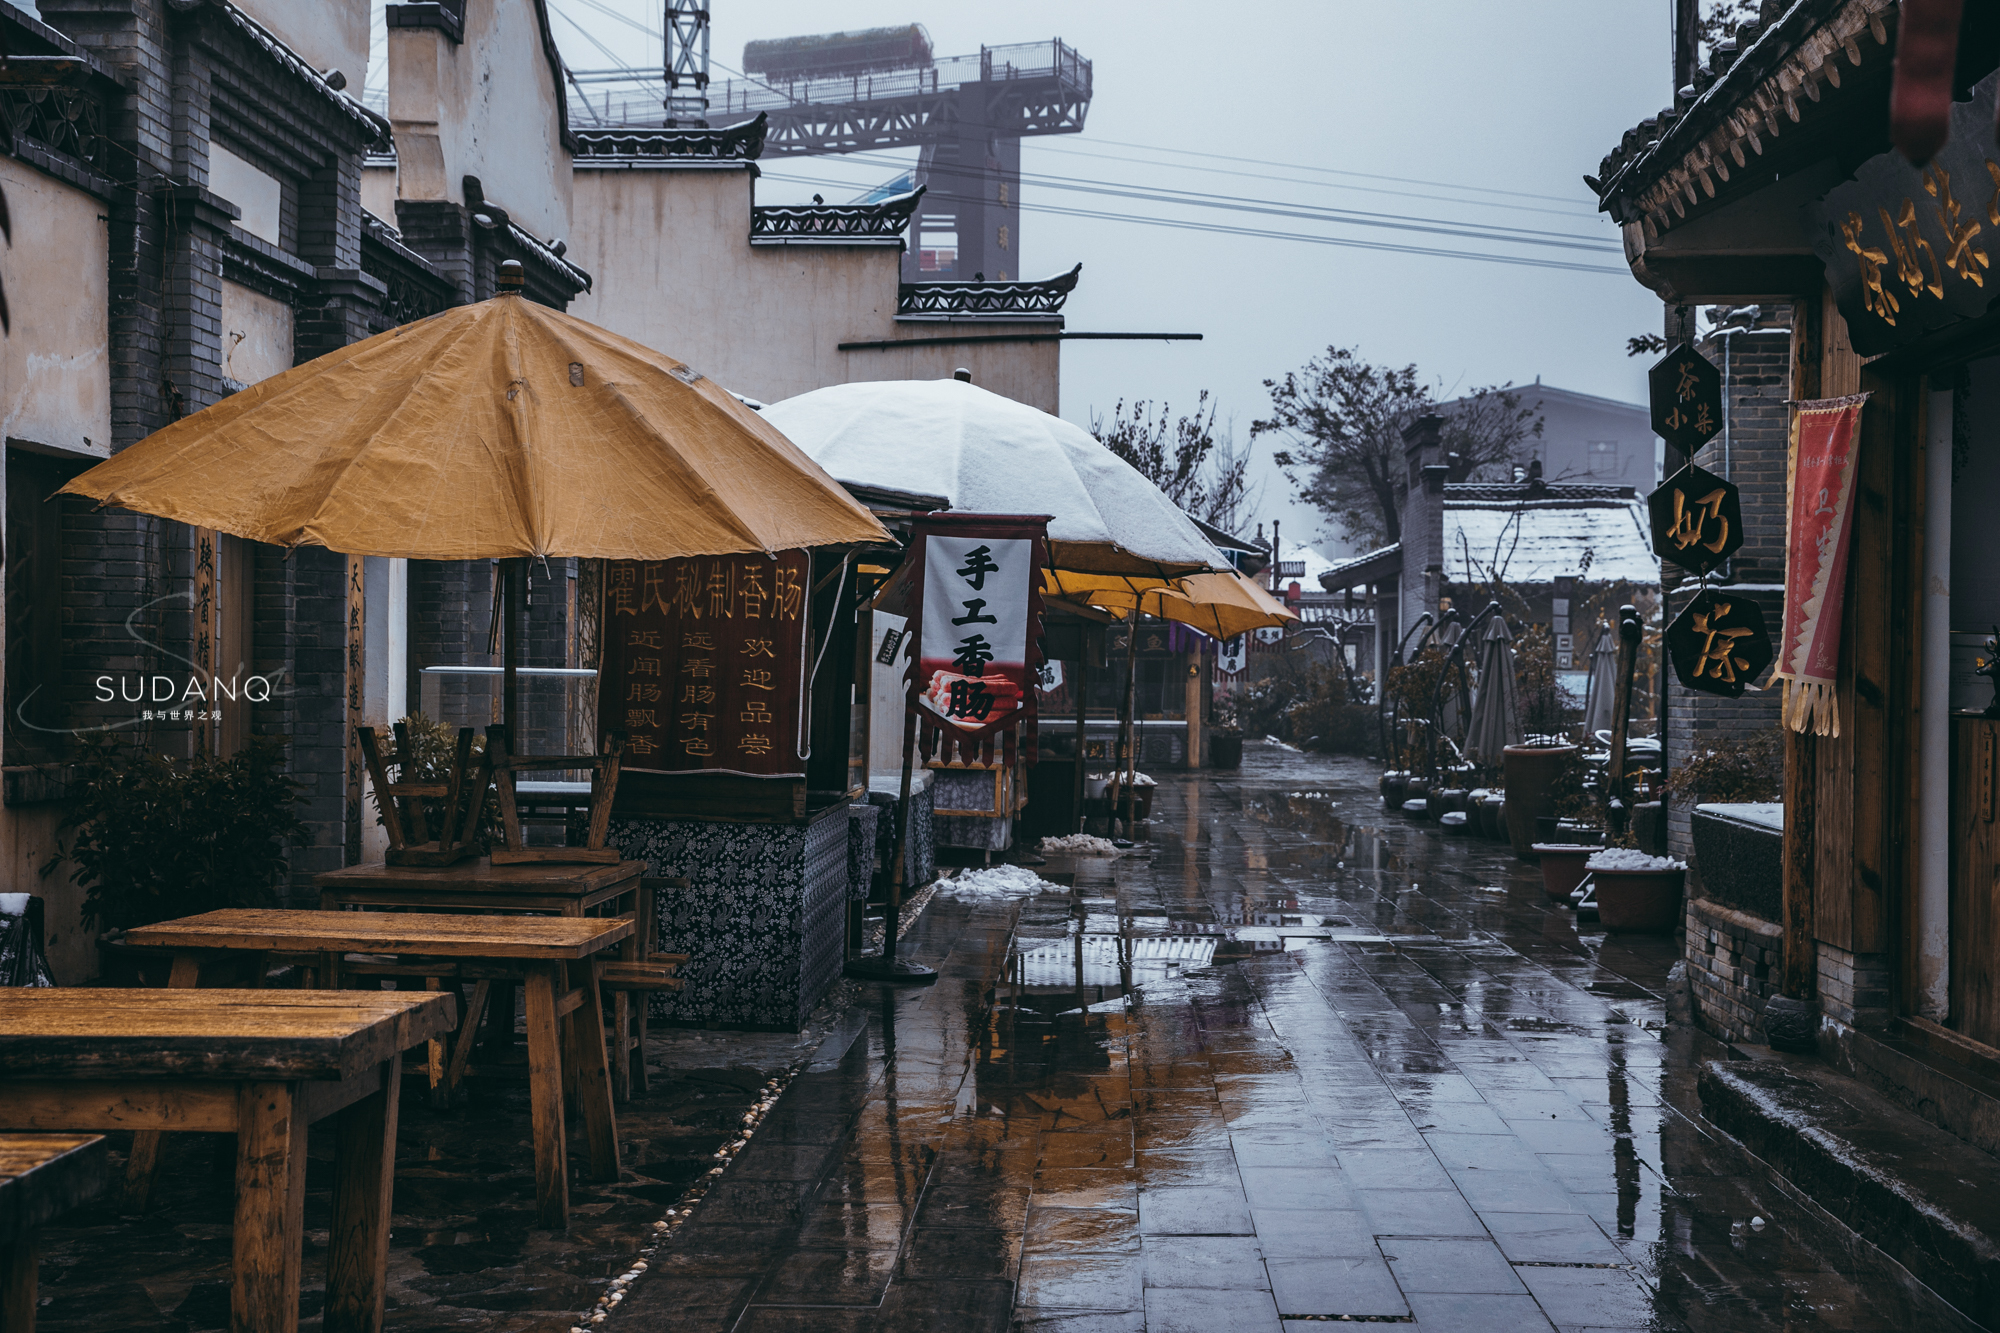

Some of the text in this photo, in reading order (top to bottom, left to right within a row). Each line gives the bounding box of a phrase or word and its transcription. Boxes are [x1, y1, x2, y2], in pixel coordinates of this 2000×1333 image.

[1675, 361, 1700, 402] 茶
[1666, 487, 1730, 554] 奶
[607, 559, 803, 621] 霍氏秘制香肠
[945, 544, 1000, 722] 手工香肠
[625, 630, 664, 755] 近闻肠飘香
[1692, 602, 1755, 683] 茶
[679, 631, 717, 757] 远看肠有色
[737, 637, 778, 756] 欢迎品尝
